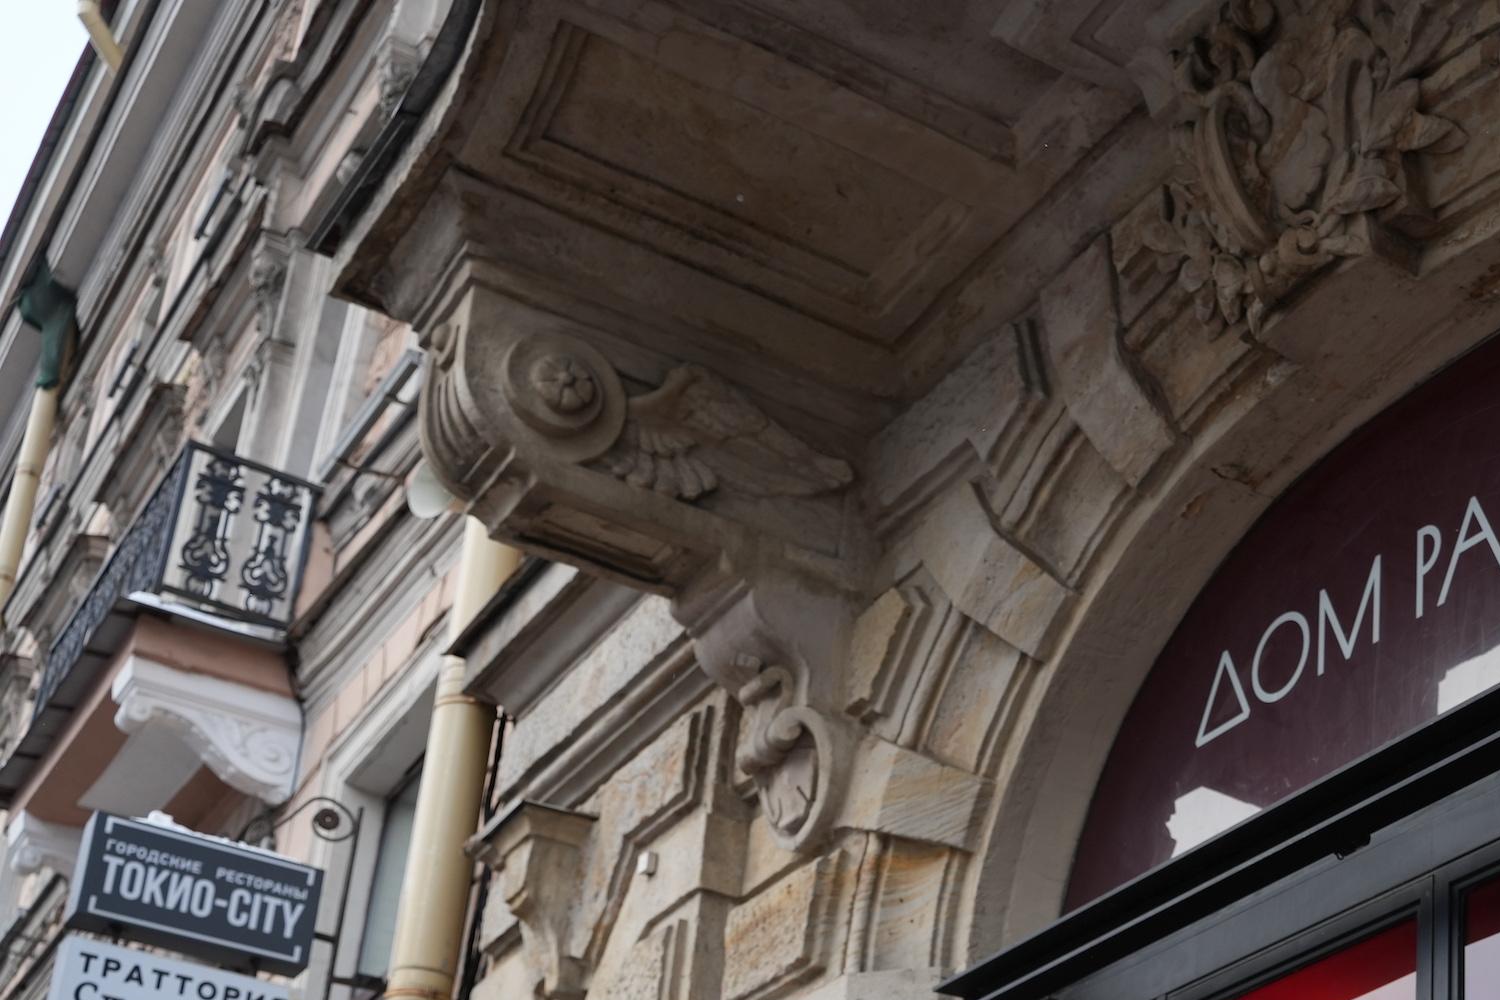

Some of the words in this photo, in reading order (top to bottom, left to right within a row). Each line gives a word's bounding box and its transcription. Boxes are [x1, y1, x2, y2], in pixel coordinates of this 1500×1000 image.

[1195, 553, 1382, 748] ДОМ
[102, 854, 306, 940] ТОКИО-CITY
[105, 839, 203, 875] ГОРОДСКИЕ
[215, 867, 309, 900] РЕСТОРАНЫ
